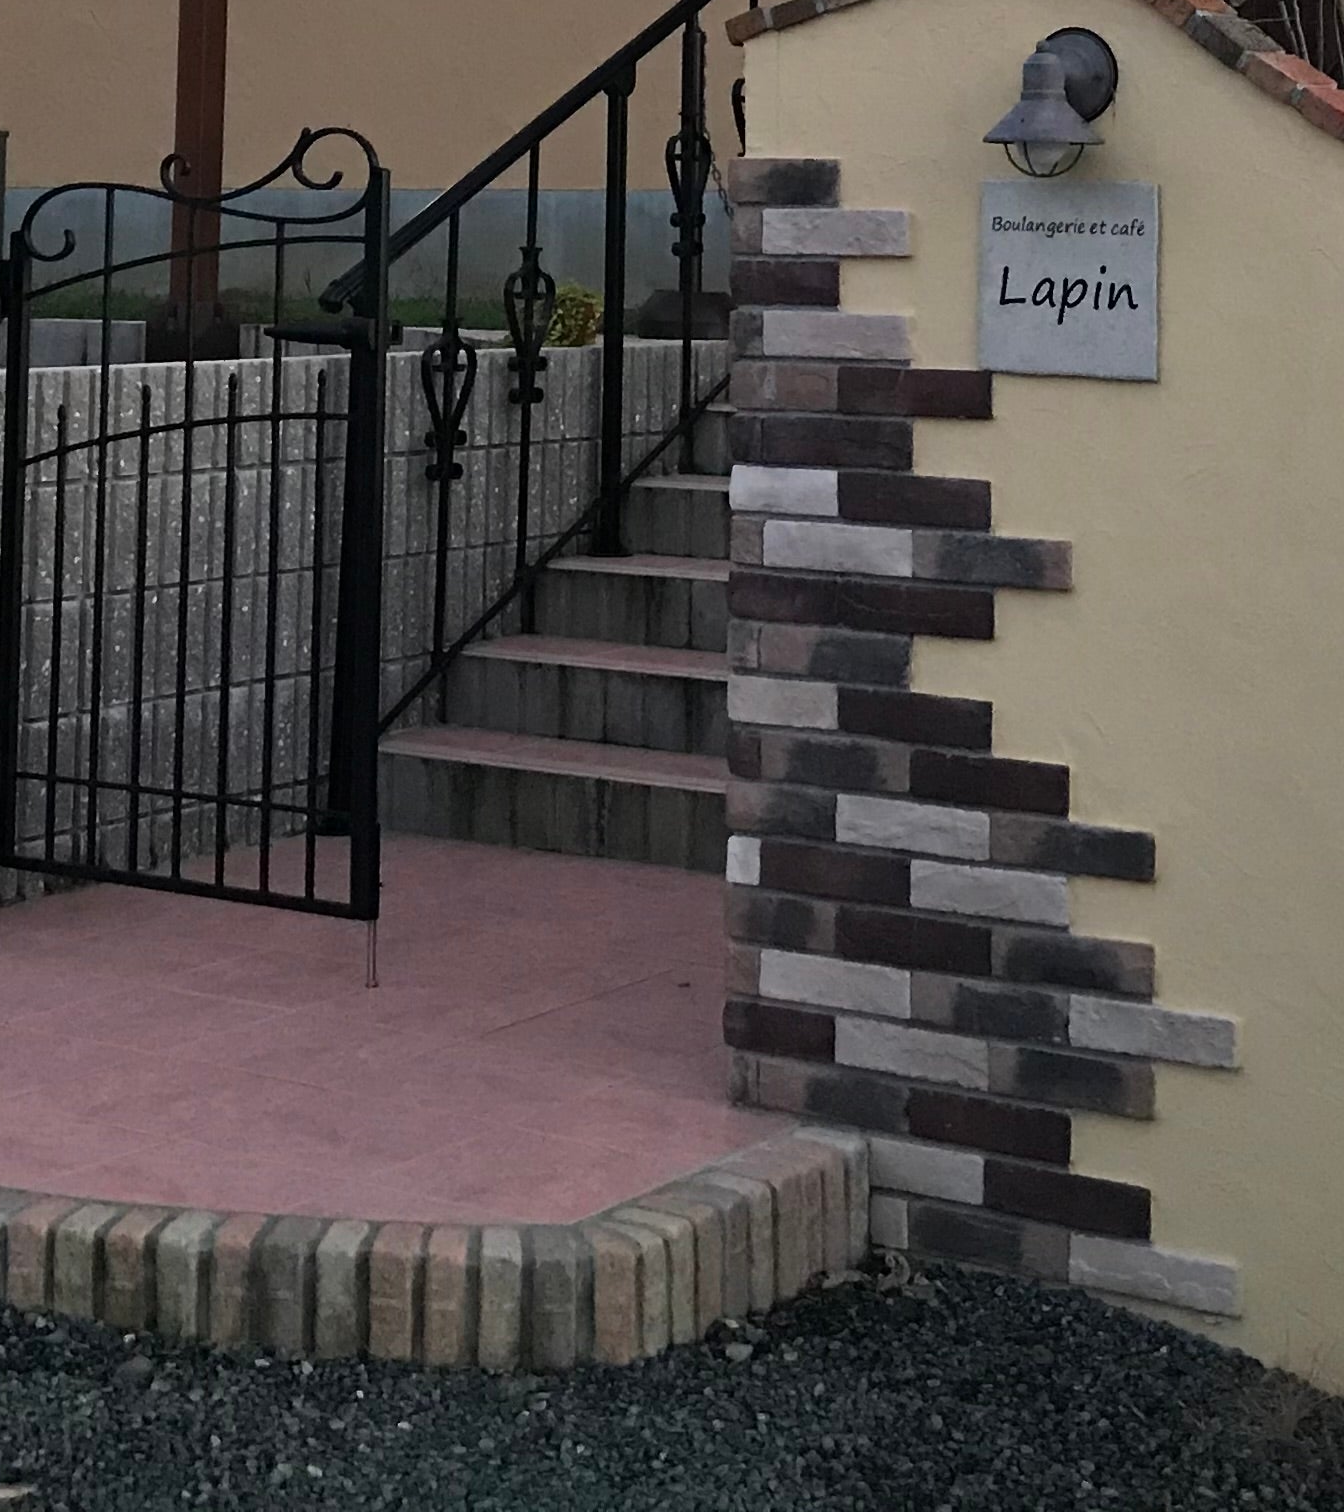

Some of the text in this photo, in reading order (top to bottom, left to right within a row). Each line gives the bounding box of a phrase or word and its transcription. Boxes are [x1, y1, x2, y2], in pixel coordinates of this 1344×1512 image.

[992, 216, 1145, 238] Boulangerie et café
[999, 265, 1139, 326] Lapin
